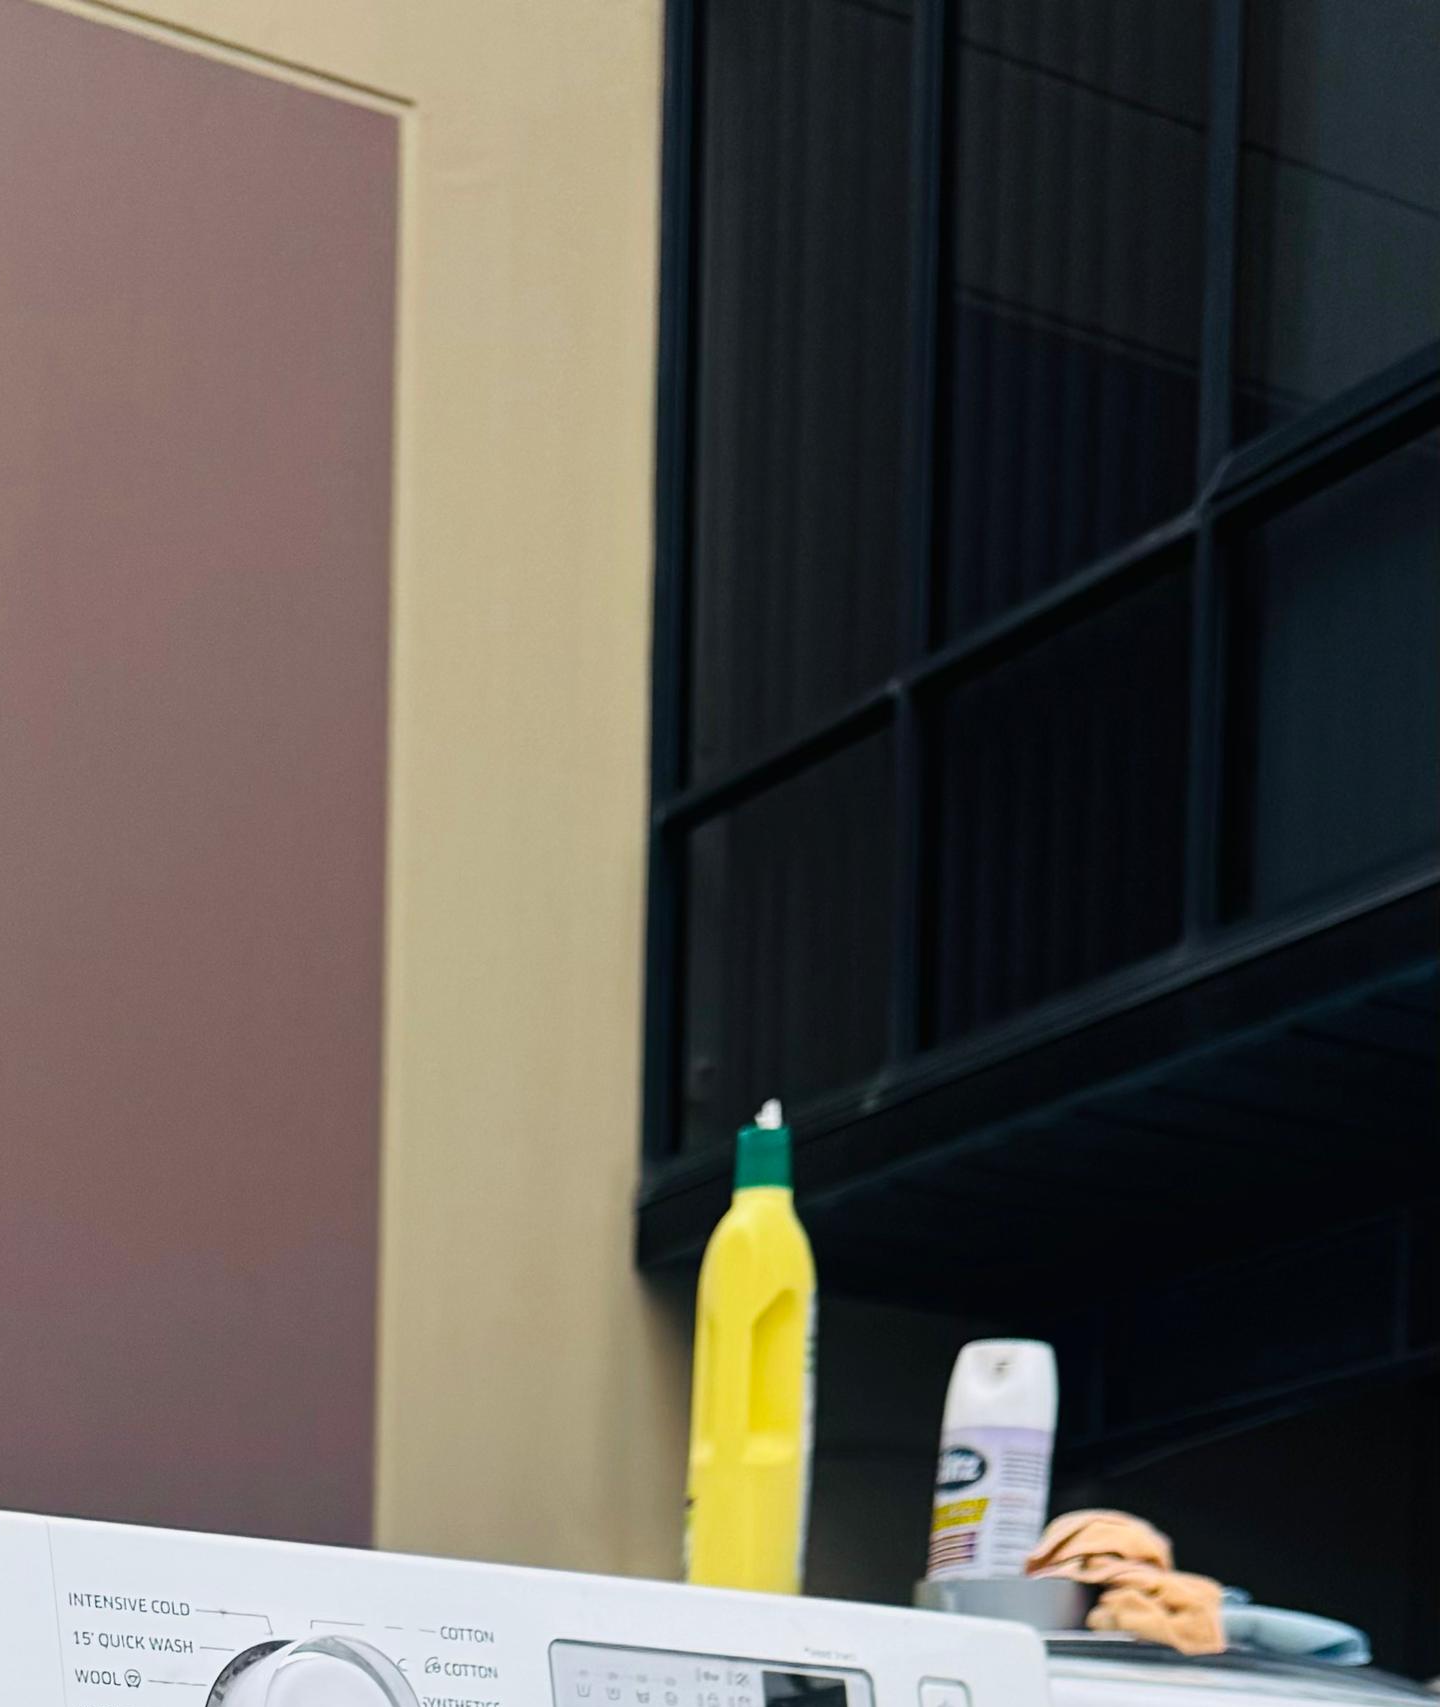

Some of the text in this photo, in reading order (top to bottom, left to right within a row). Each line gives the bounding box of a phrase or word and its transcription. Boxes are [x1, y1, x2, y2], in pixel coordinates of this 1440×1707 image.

[68, 1592, 190, 1616] INTENSIVE COLD
[98, 1632, 145, 1650] QUICK
[149, 1637, 193, 1653] WASH
[439, 1626, 494, 1643] COTTON
[75, 1669, 121, 1686] WOOL
[444, 1662, 498, 1679] COTTON
